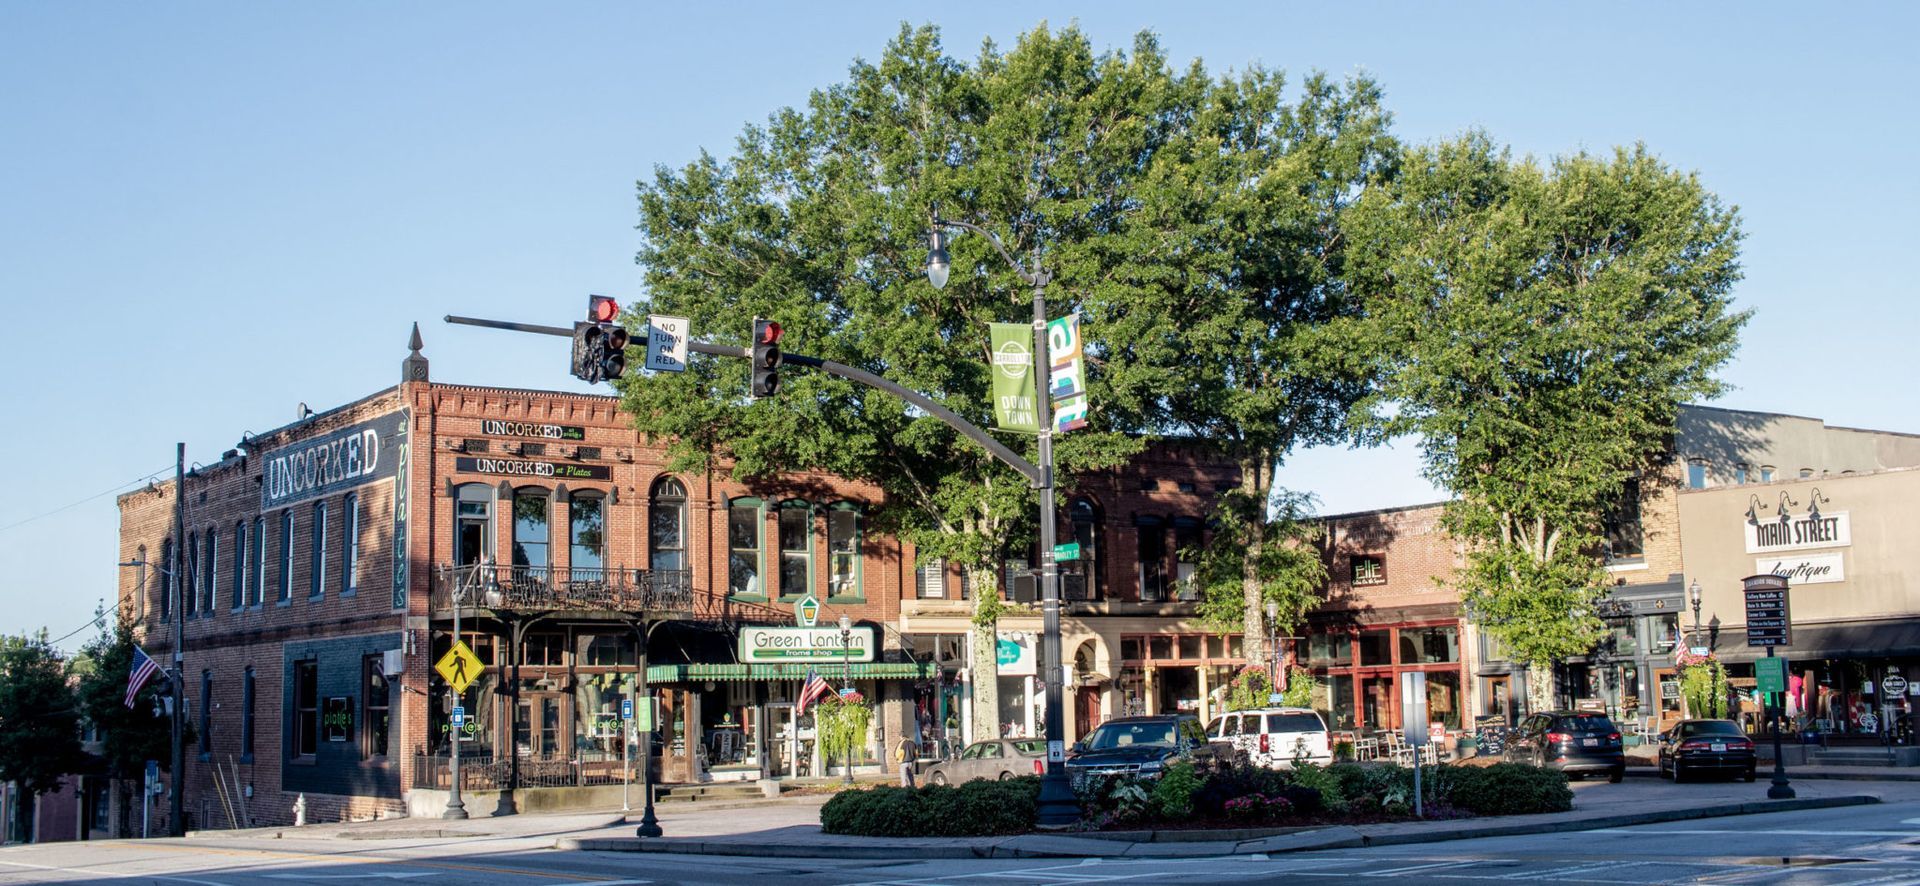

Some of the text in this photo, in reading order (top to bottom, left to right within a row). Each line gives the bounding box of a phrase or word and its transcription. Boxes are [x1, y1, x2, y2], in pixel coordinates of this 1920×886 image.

[662, 323, 676, 332] NO
[655, 333, 682, 343] TURN
[660, 345, 674, 354] ON
[655, 355, 676, 365] RED
[1002, 396, 1031, 410] DOWN
[1004, 410, 1033, 425] TOWN
[486, 420, 563, 439] UNCORKED
[269, 428, 379, 500] UNCORKED
[476, 458, 555, 477] UNCORKED
[566, 465, 592, 477] Plates
[1756, 517, 1839, 547] MAIN STREET
[1770, 561, 1831, 583] boutique
[754, 631, 802, 647] Green
[324, 709, 352, 729] plates
